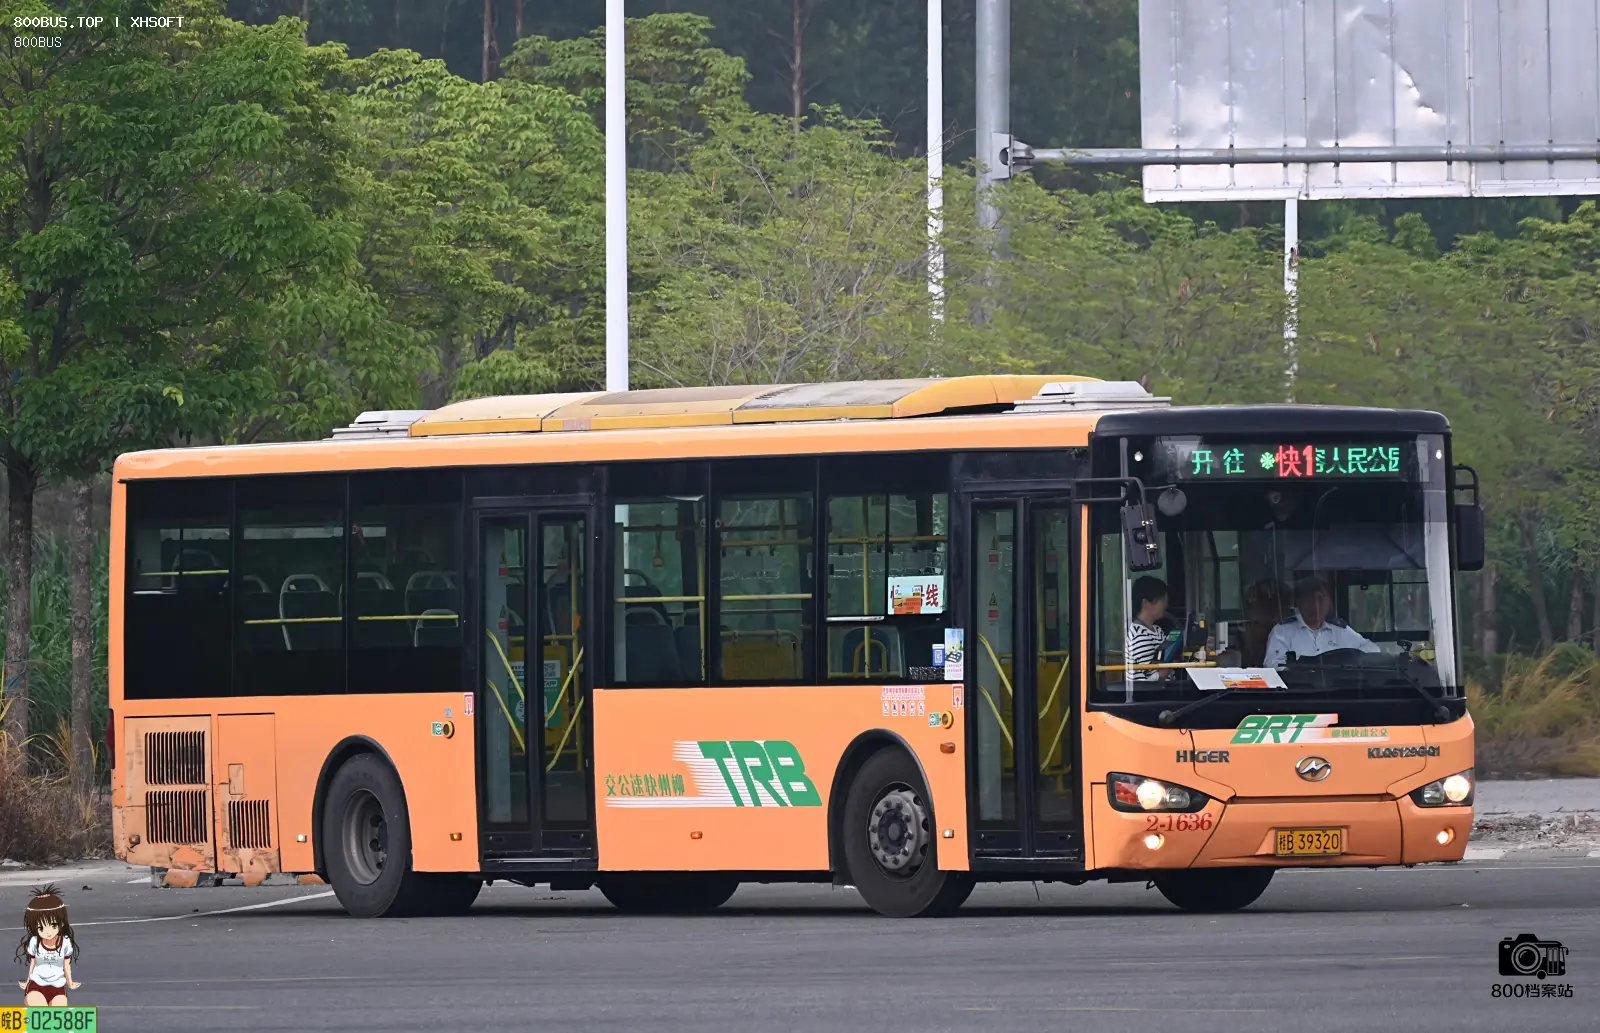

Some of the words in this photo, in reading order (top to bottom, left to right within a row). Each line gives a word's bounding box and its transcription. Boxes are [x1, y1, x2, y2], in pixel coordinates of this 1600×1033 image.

[1229, 714, 1318, 744] BRT
[1175, 750, 1230, 763] HIGER
[1145, 812, 1213, 832] 2-1636
